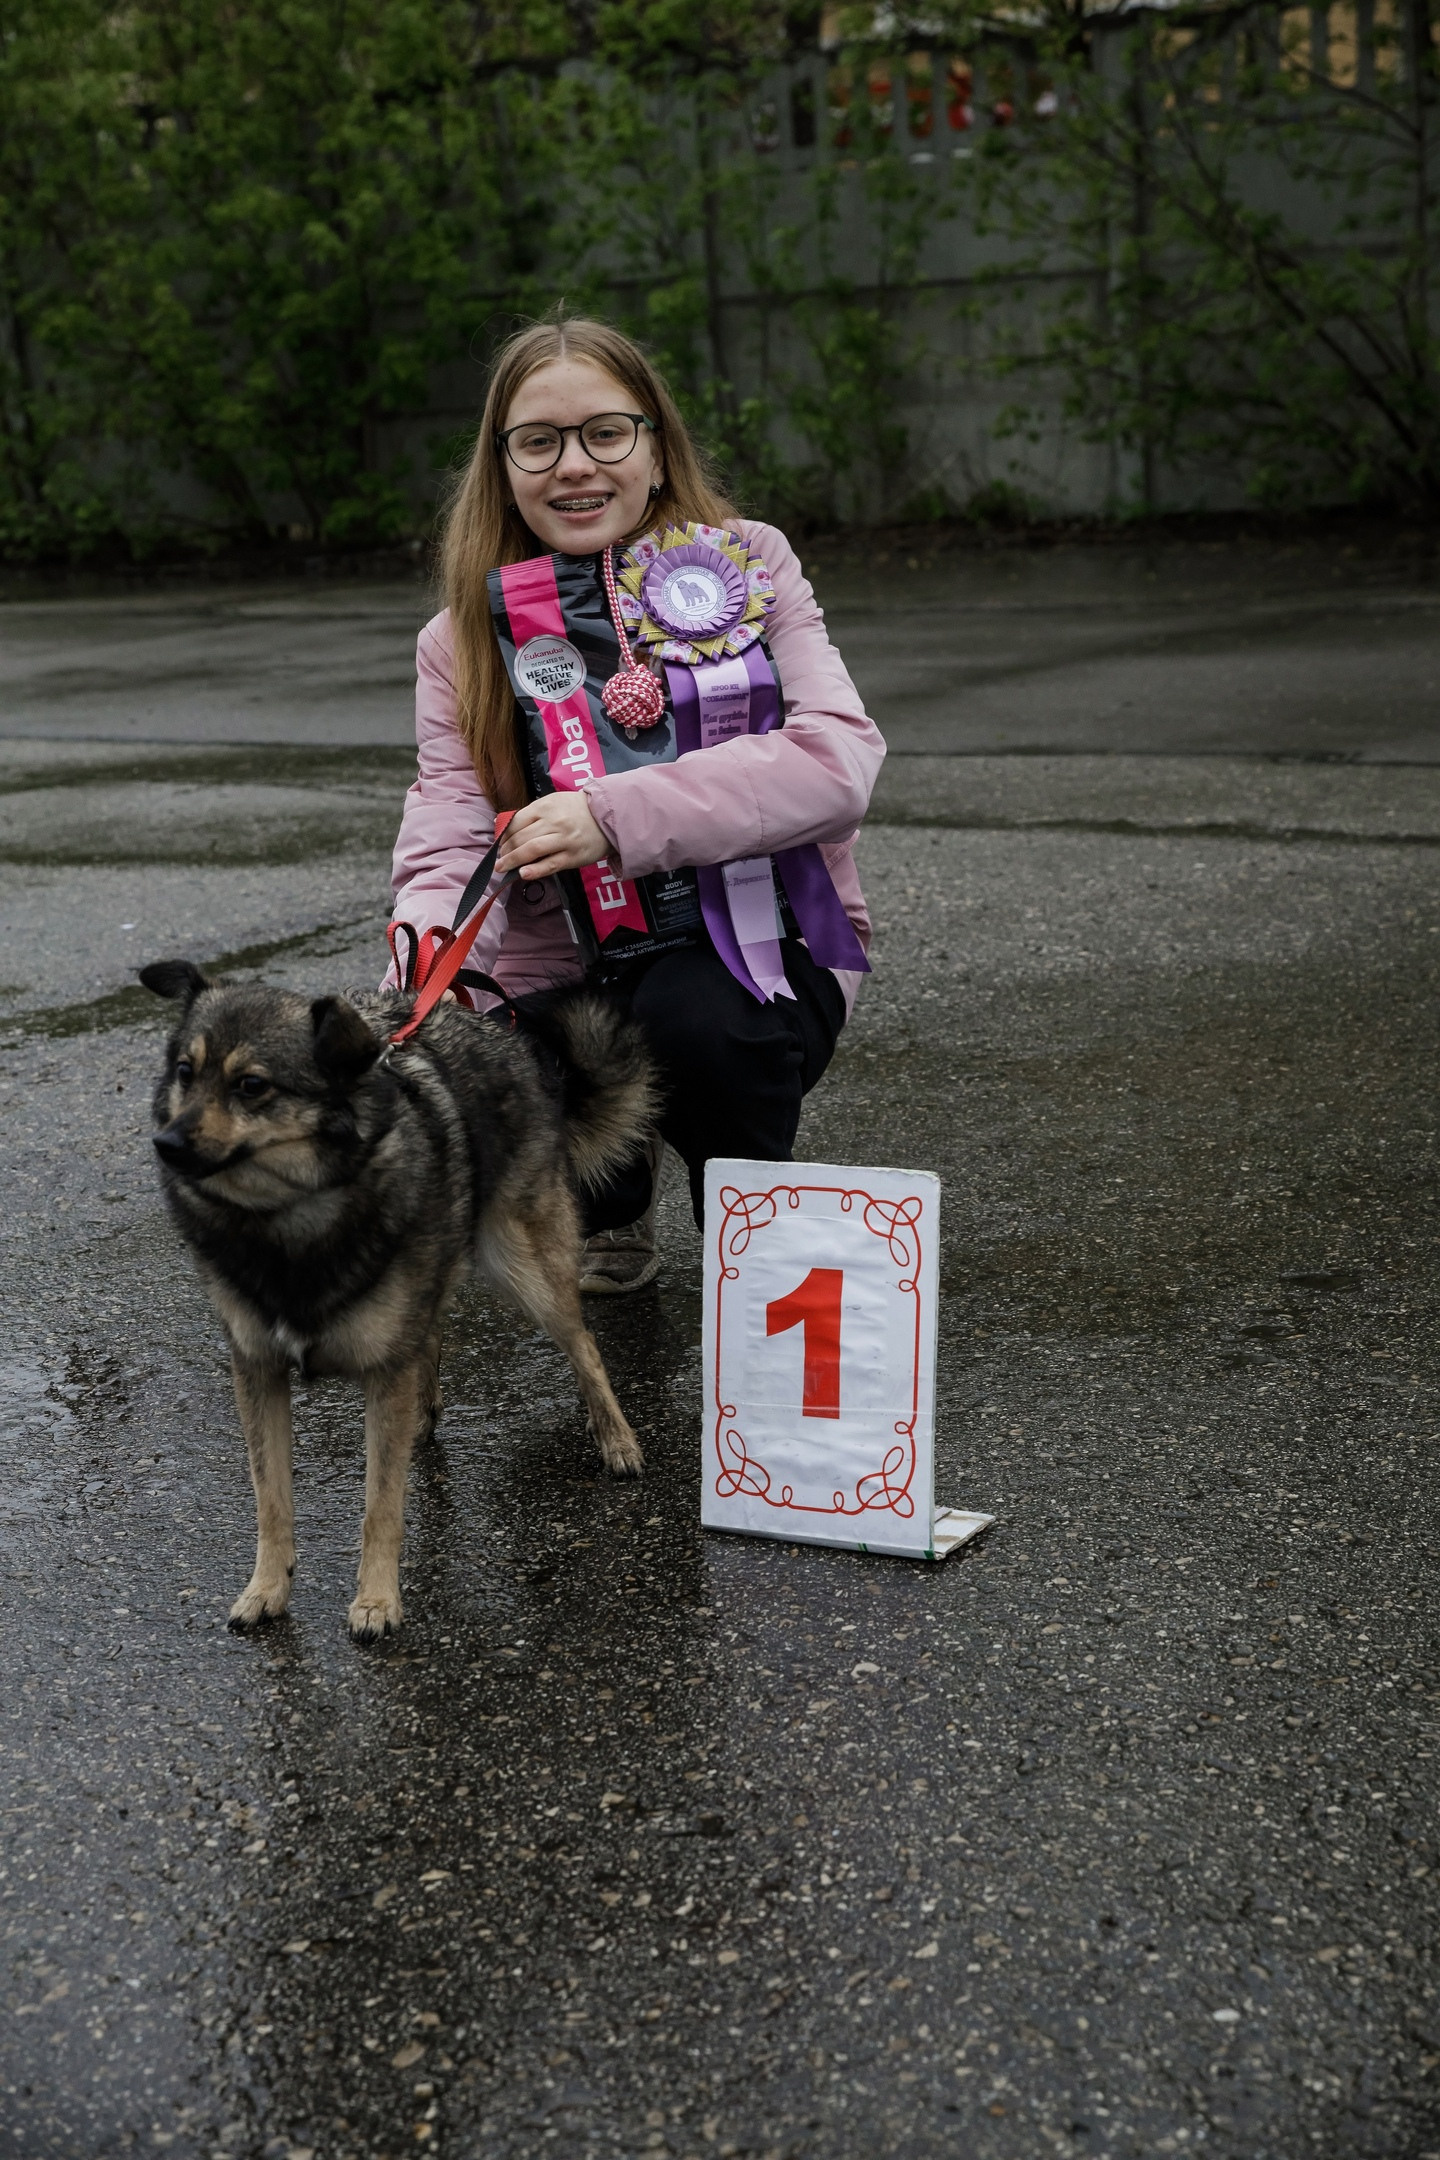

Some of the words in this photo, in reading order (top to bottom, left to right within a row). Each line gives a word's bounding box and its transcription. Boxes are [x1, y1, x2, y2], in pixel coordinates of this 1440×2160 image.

[524, 647, 564, 661] Eukanuba
[531, 657, 558, 667] DEDICATED
[526, 661, 575, 680] HEALTHY
[535, 672, 573, 687] ACTIVE
[541, 678, 571, 694] LIVES
[664, 880, 683, 890] BODY
[637, 943, 666, 955] АКТИВНОЙ
[766, 1268, 843, 1419] 1
